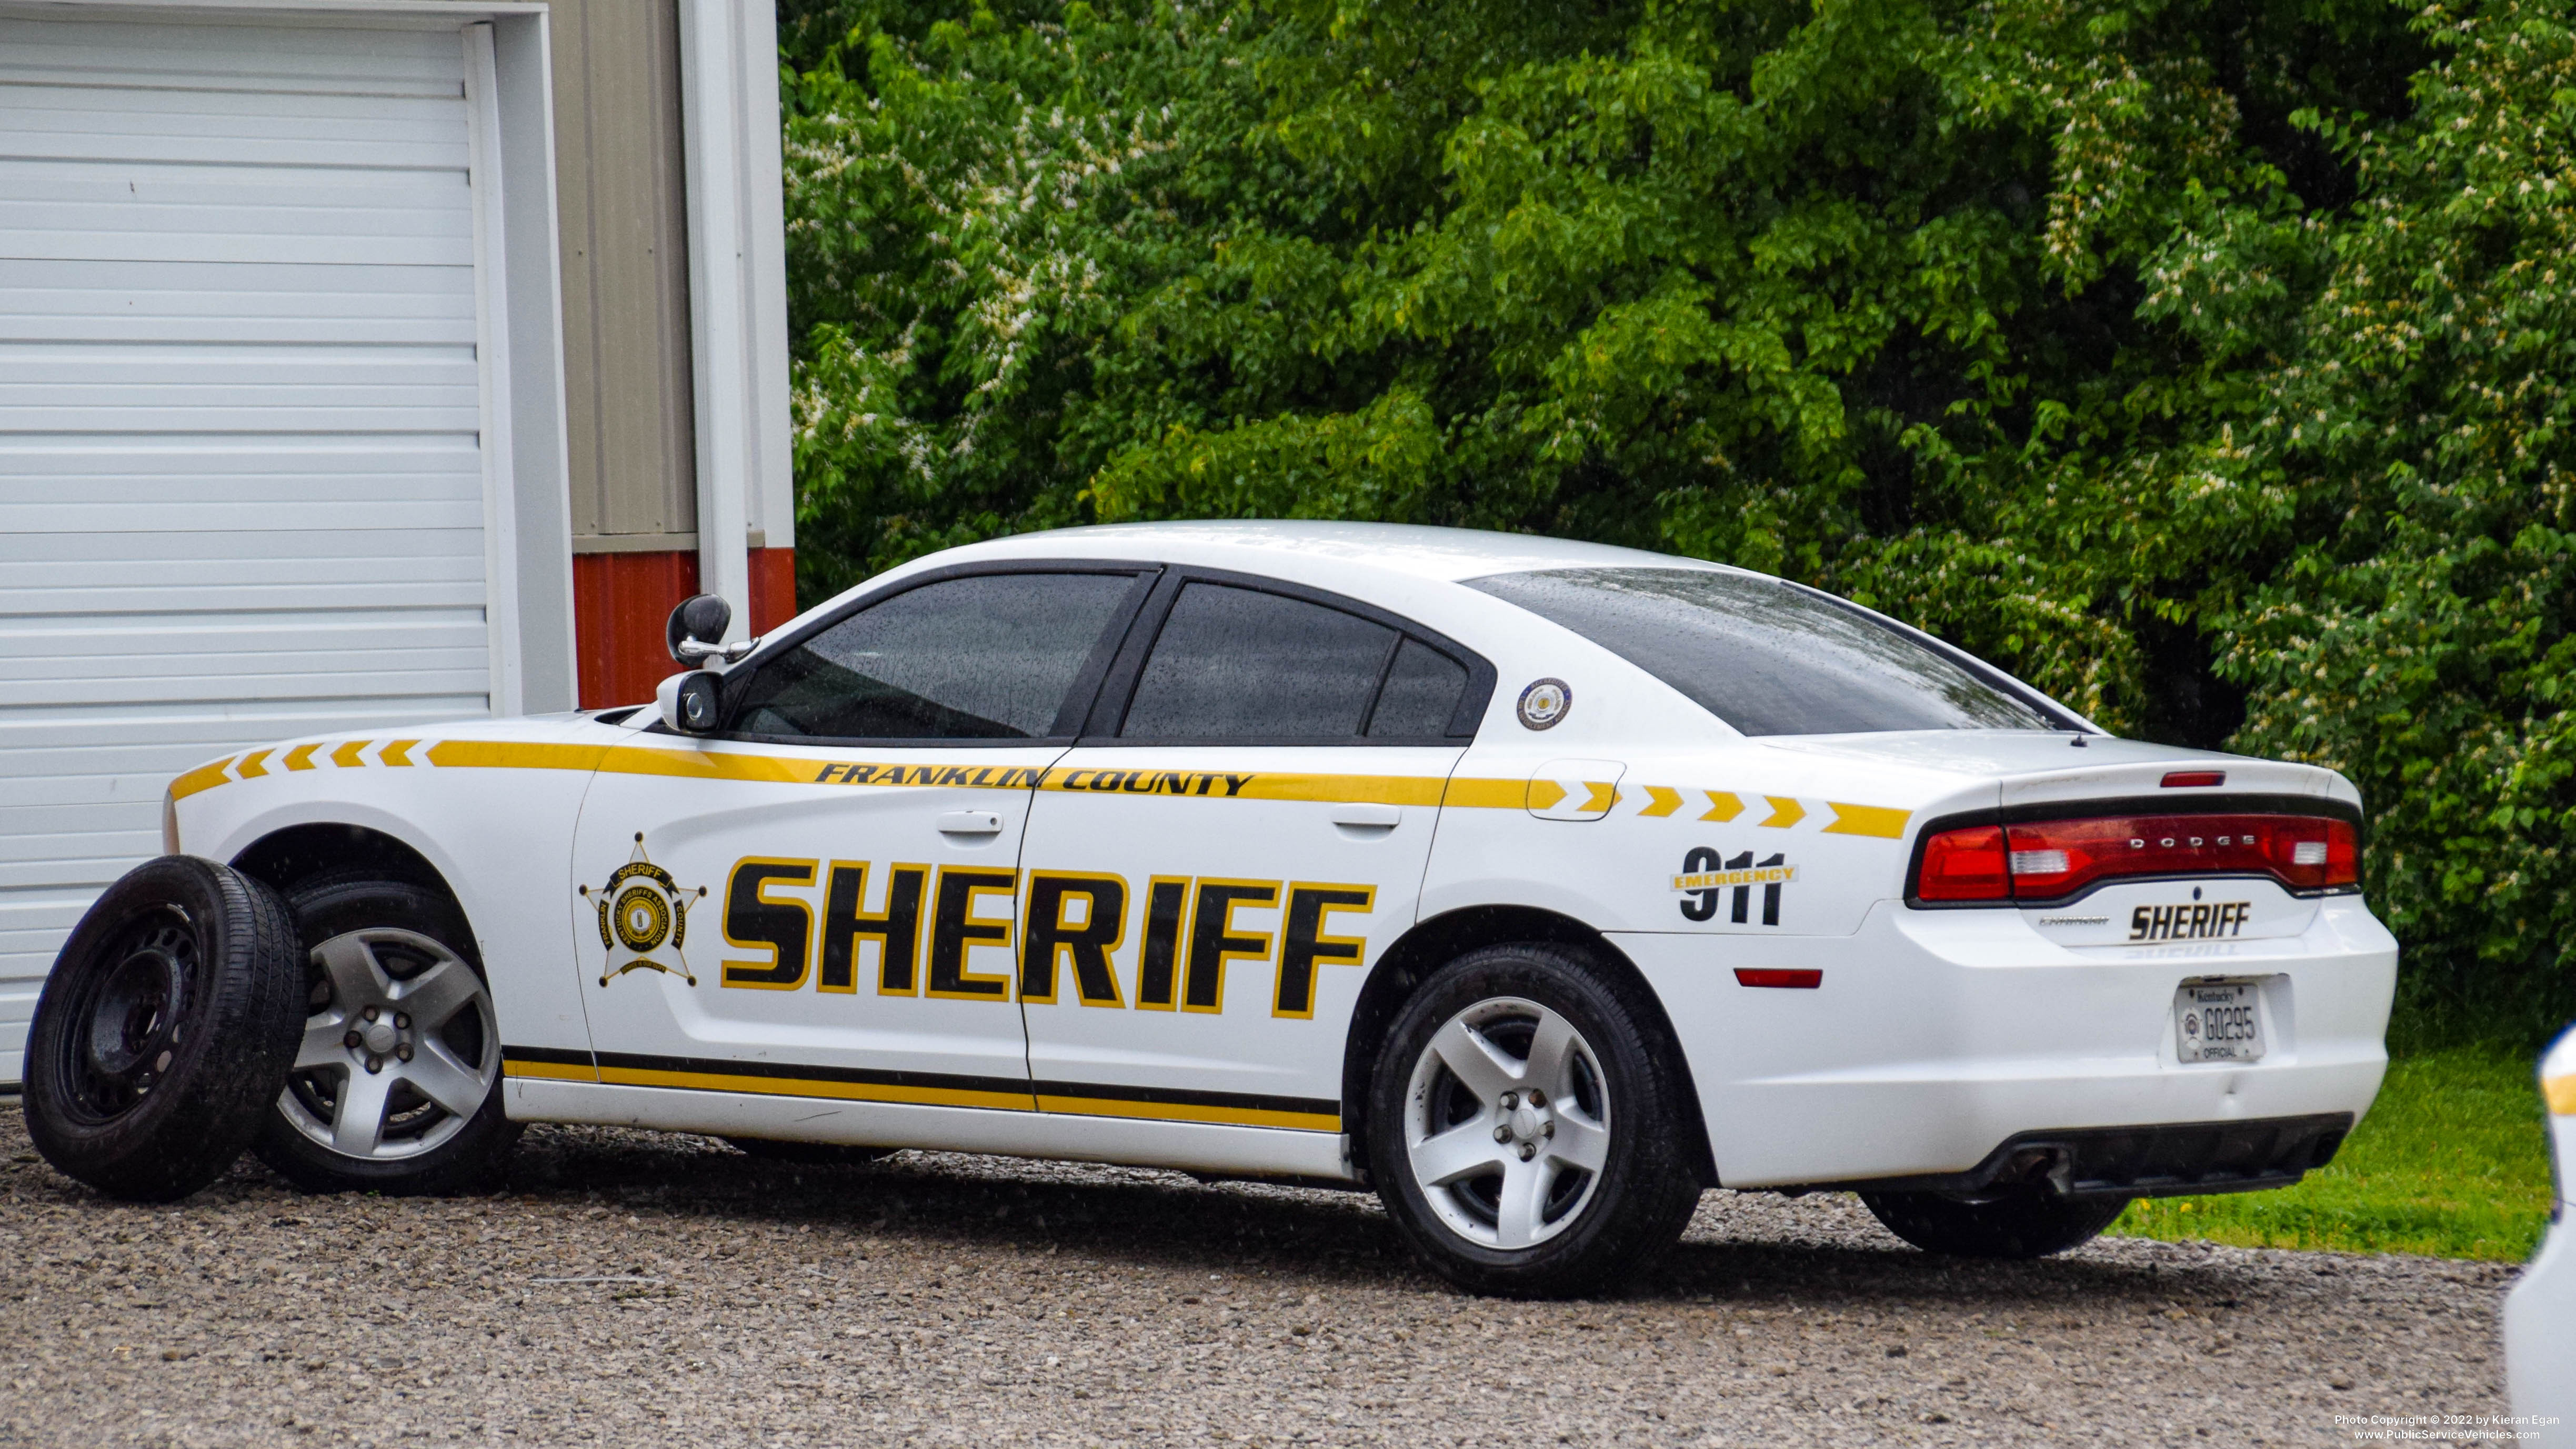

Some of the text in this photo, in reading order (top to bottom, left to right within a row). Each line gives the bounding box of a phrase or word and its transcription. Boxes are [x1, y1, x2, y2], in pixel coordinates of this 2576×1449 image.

[815, 763, 1256, 796] FRANKLIN COUNTY
[2130, 835, 2256, 848] DODGE
[618, 864, 662, 880] SHERIFF
[1674, 867, 1795, 888] EMERGENCY
[1680, 846, 1785, 926] 911
[622, 889, 652, 904] SHERIFFS
[599, 904, 611, 945] FRANKLIN
[616, 904, 631, 944] KENTUCKY
[650, 896, 667, 945] ASSOCIATION
[2129, 902, 2251, 940] SHERIFF
[720, 855, 1379, 1021] SHERIFF
[2197, 990, 2234, 1004] Kentucky
[2203, 1047, 2237, 1058] OFFICIAL
